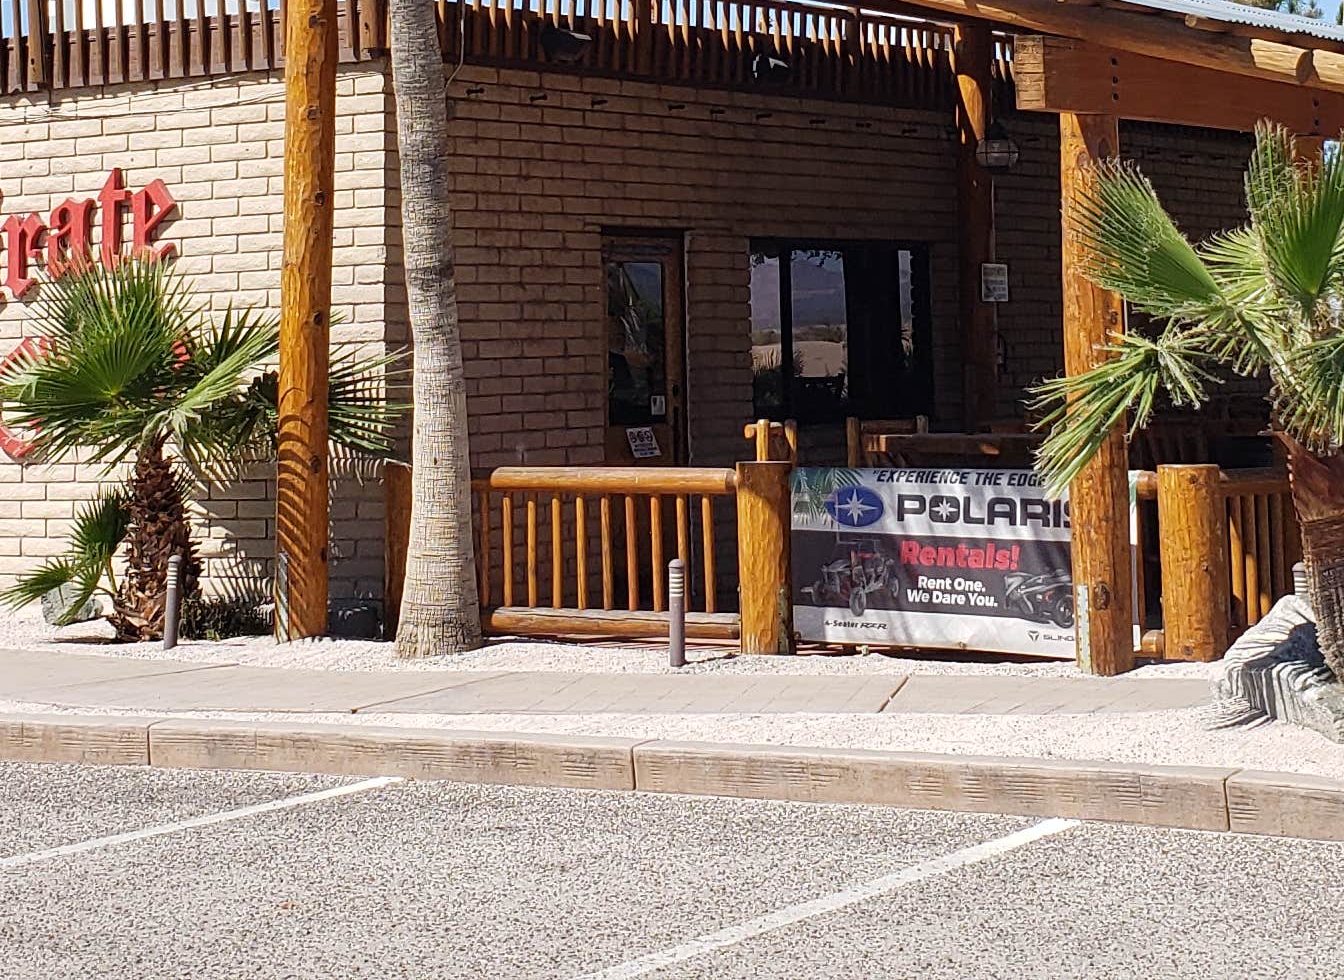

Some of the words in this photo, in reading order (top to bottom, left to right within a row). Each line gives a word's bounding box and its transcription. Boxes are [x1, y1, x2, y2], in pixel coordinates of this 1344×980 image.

[974, 471, 1003, 486] THE
[896, 493, 1070, 528] POLARI
[899, 539, 1021, 570] Rentals!
[917, 575, 953, 590] Rent
[953, 576, 987, 592] One.
[906, 588, 930, 603] We
[932, 589, 965, 605] Dare
[967, 590, 998, 607] You.
[824, 619, 858, 629] 4-Seater
